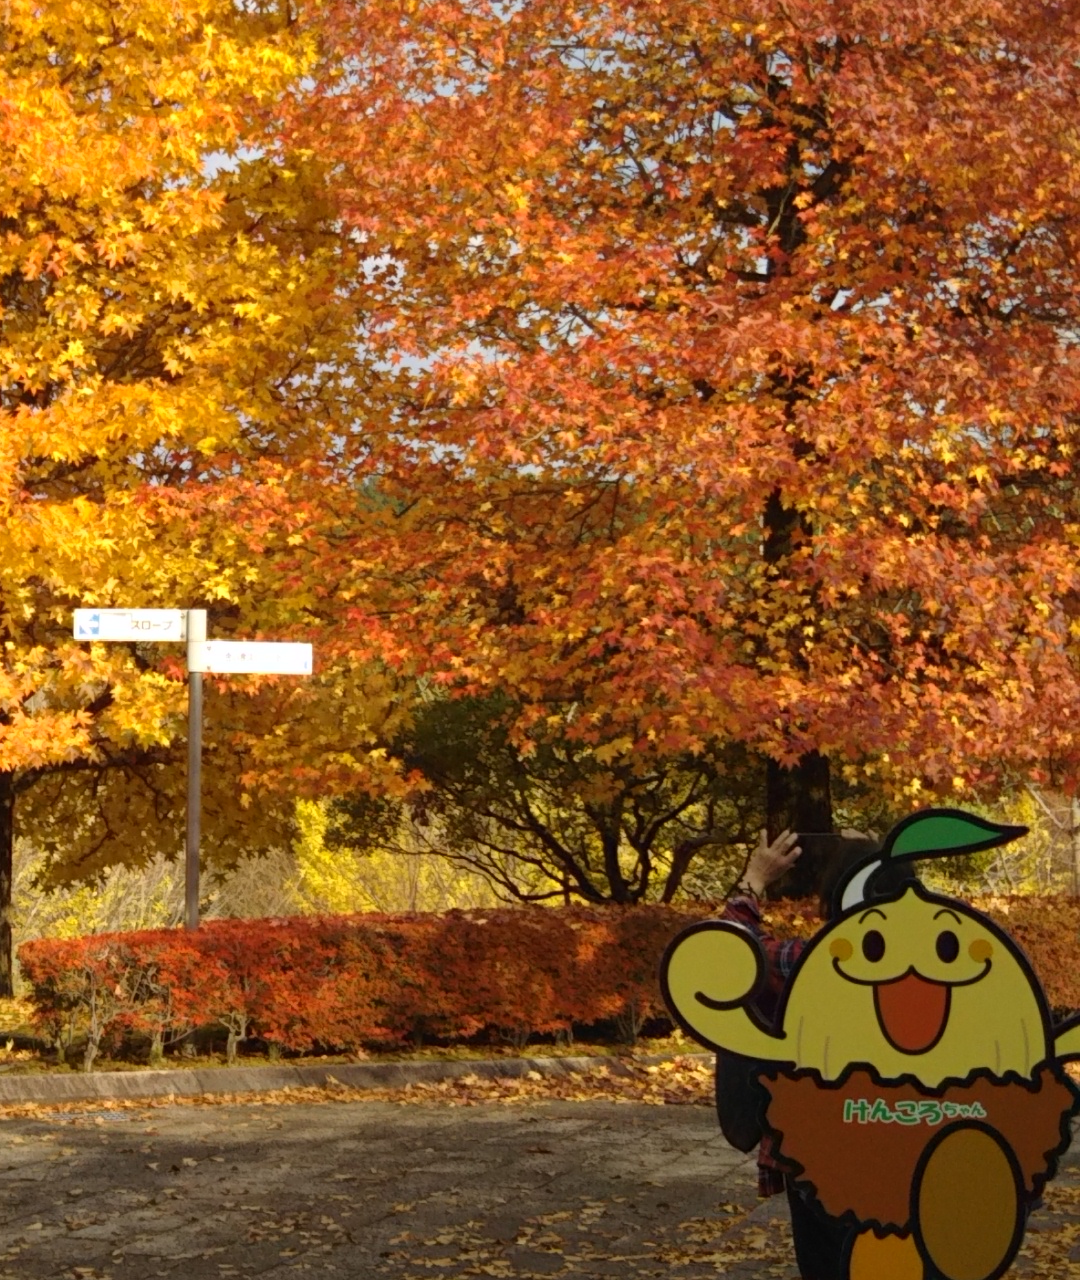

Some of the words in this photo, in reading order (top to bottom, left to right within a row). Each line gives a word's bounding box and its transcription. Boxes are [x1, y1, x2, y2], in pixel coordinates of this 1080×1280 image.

[843, 1098, 987, 1126] けんころちゃん
